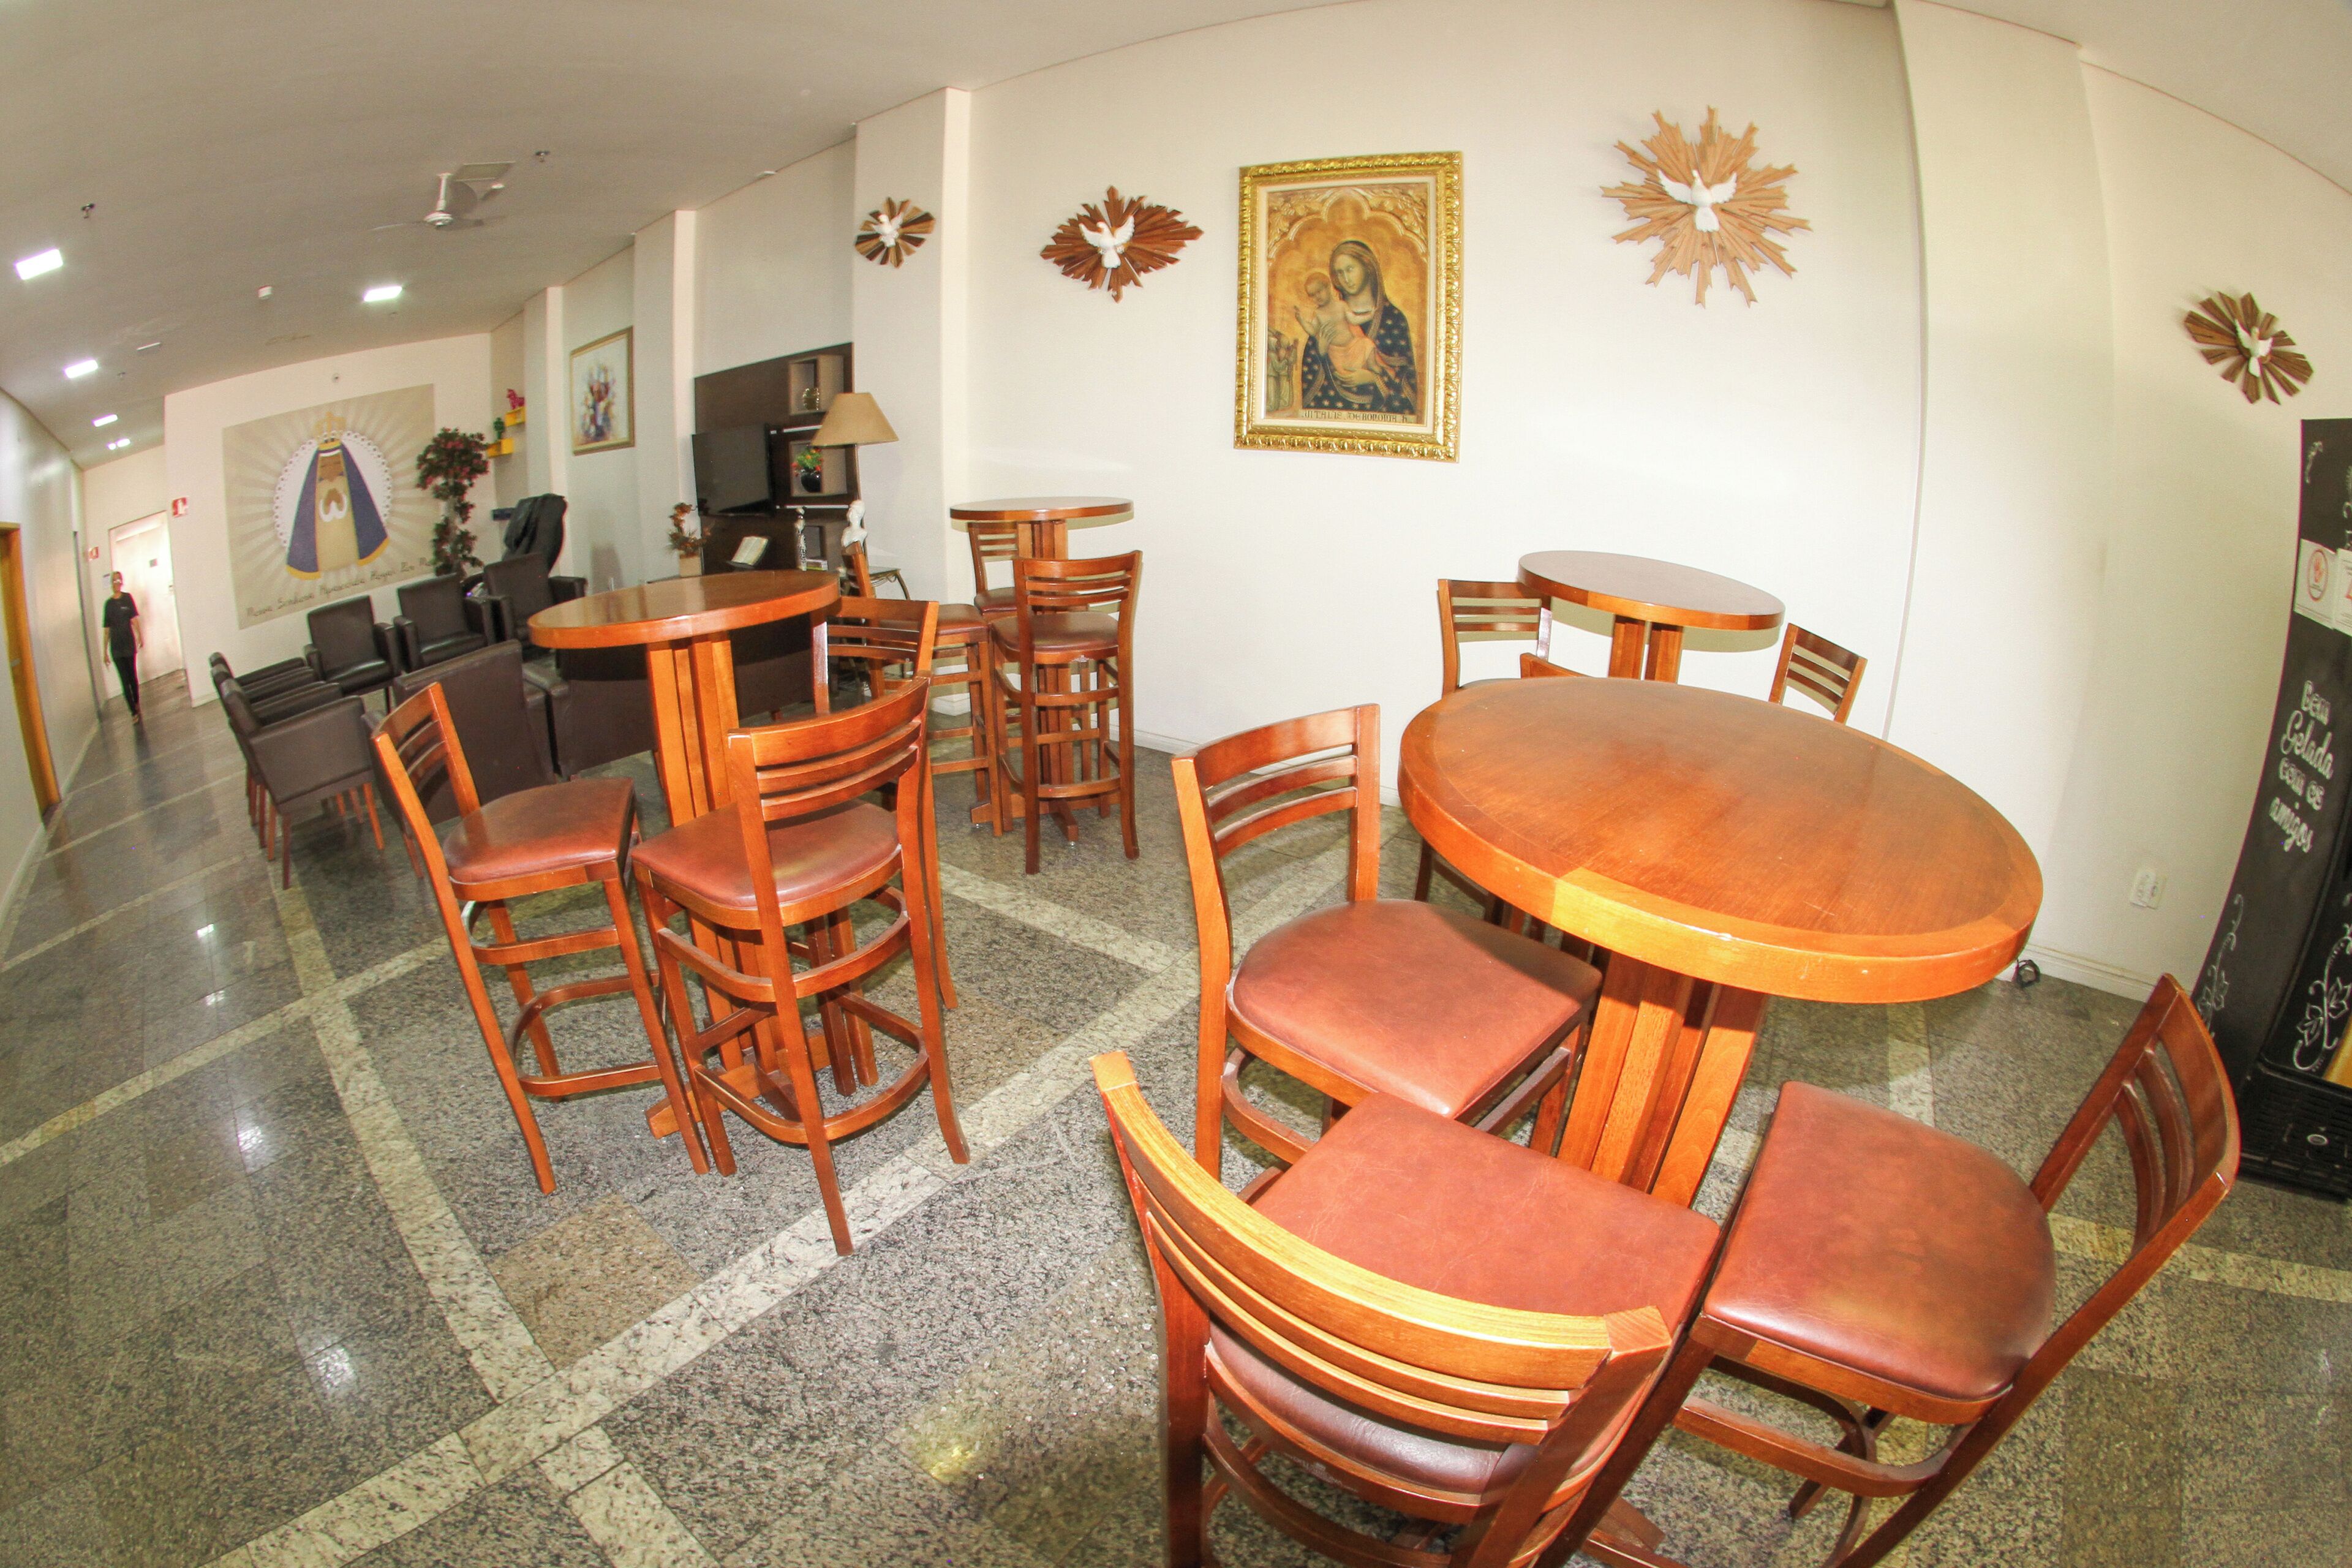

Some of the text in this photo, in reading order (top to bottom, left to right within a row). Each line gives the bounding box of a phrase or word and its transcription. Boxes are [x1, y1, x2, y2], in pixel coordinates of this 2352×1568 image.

[2301, 680, 2331, 725] Bem
[2280, 710, 2334, 780] Gelada
[2269, 797, 2313, 853] amigos
